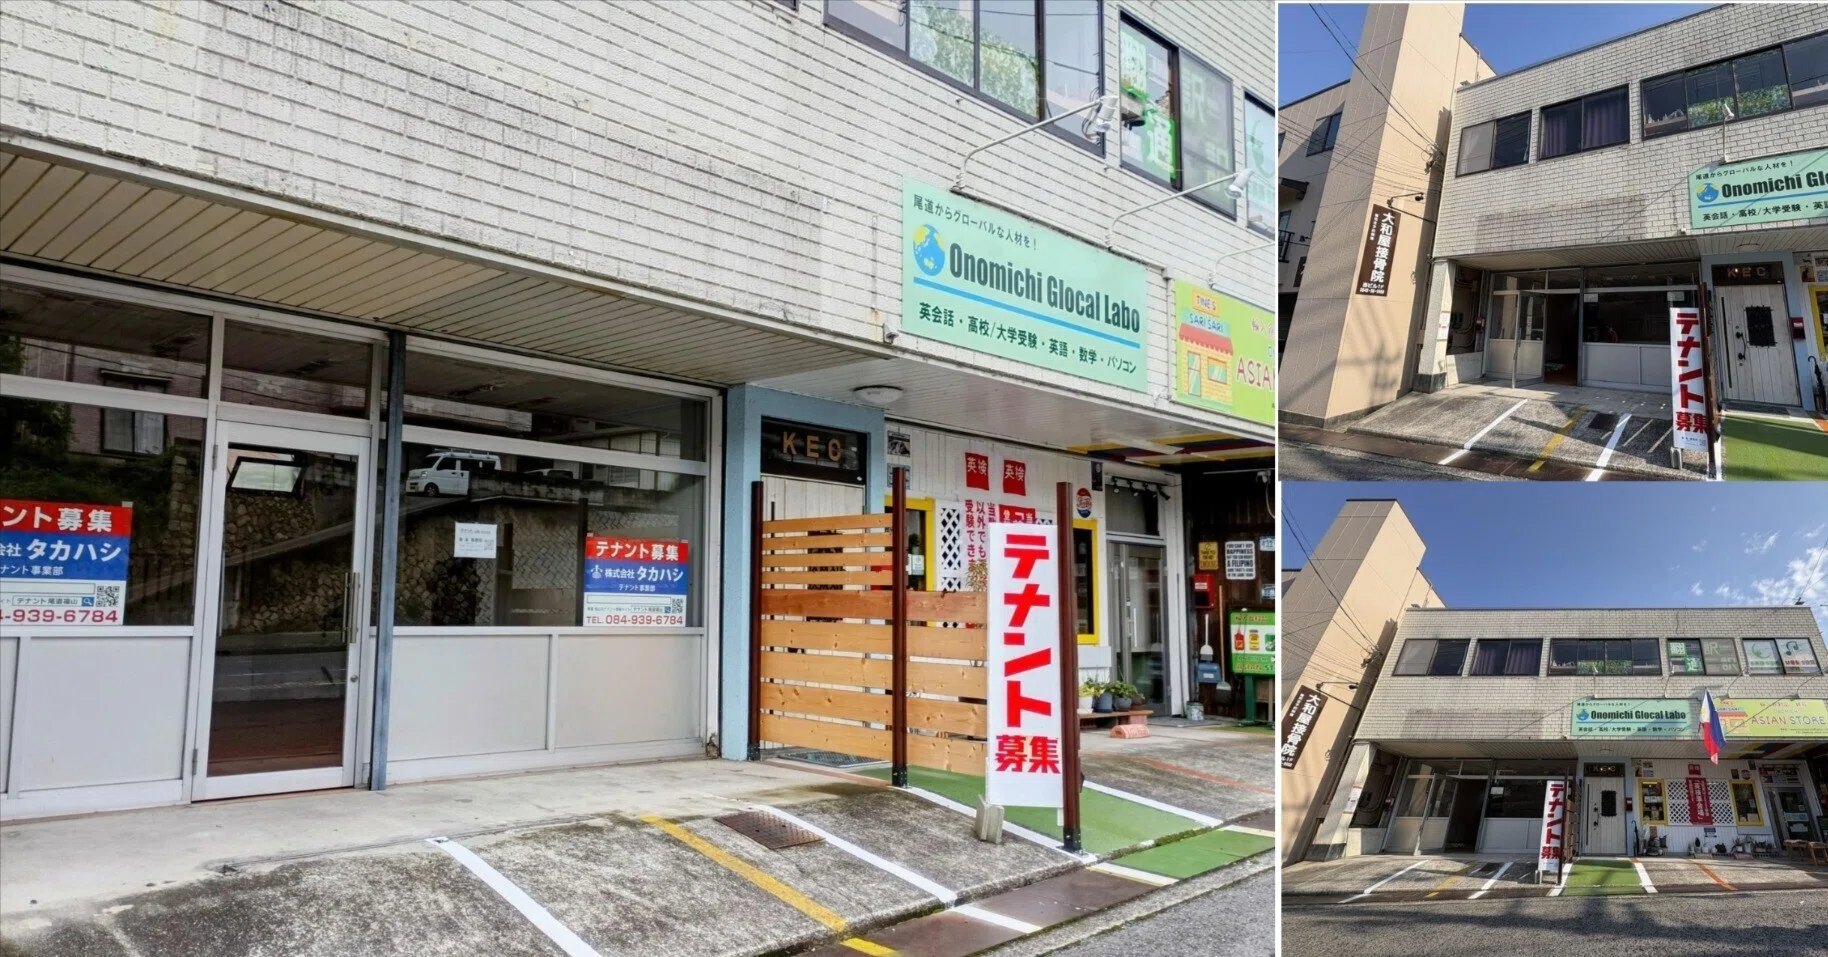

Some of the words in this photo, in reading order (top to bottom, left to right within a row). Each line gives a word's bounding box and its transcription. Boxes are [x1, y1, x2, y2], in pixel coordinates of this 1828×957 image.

[1721, 173, 1803, 198] Onomichi
[949, 242, 1044, 304] Onomichi
[1047, 273, 1102, 328] Glocal
[1103, 294, 1141, 333] Labo
[1676, 312, 1705, 409] テナント
[1676, 411, 1709, 434] 募集
[967, 456, 988, 476] 英検
[1005, 463, 1025, 482] 英検
[596, 541, 679, 561] テナント募集
[0, 608, 118, 623] -939-6784
[605, 614, 684, 625] 084-939-6784
[1003, 533, 1052, 728] テナント
[1590, 710, 1634, 720] Onomichi
[1635, 710, 1664, 720] Glocal
[1665, 710, 1687, 720] Labo
[1751, 715, 1787, 725] ASIAN
[1789, 715, 1826, 725] STORE
[995, 735, 1060, 774] 募集
[1546, 784, 1564, 845] テナント
[1541, 847, 1562, 859] 募集
